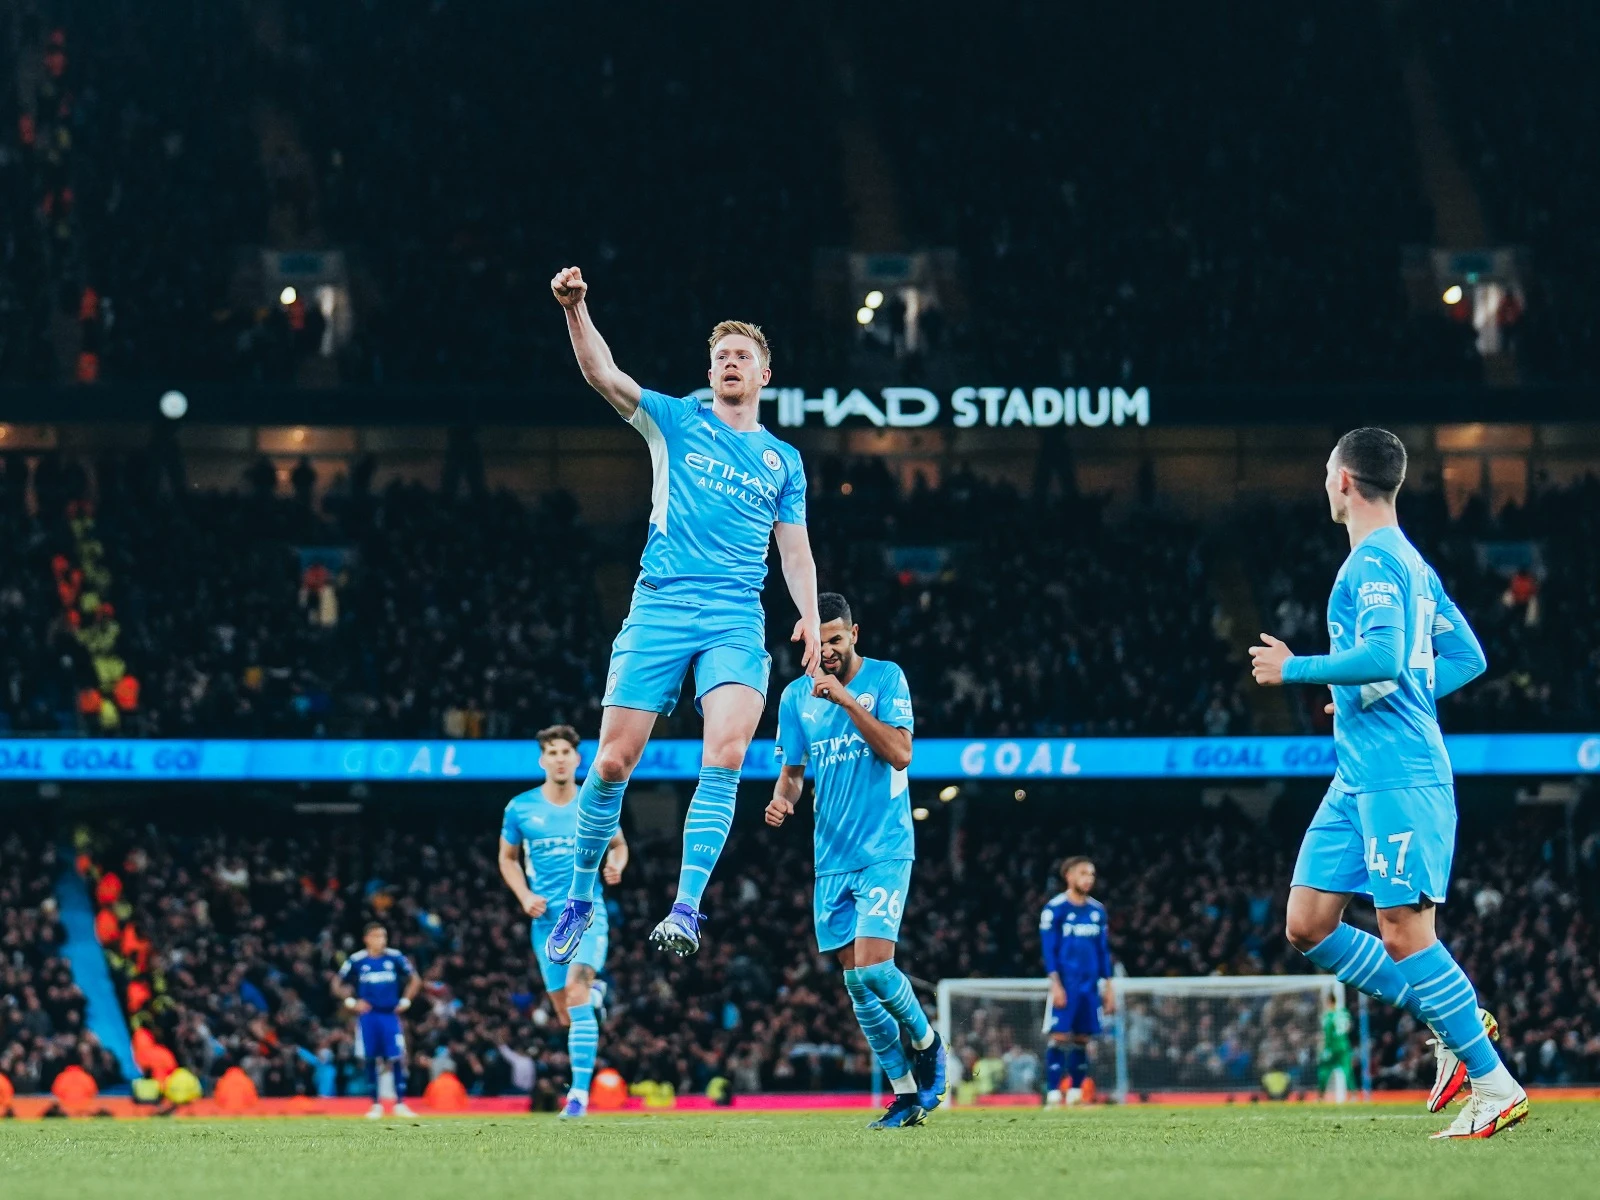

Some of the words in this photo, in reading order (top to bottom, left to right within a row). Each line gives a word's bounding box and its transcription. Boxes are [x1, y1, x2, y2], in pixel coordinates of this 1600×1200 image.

[950, 386, 1150, 427] STADIUM
[697, 477, 764, 507] AIRWAYS
[1362, 594, 1393, 606] TIRE
[1408, 595, 1438, 690] 4
[0, 748, 43, 770] OAL
[61, 747, 135, 771] GOAL
[811, 731, 866, 757] ETIHA
[960, 742, 1081, 775] GOAL
[1193, 745, 1265, 767] GOAL
[1283, 744, 1339, 766] GOA
[343, 744, 462, 776] GOAL
[693, 843, 717, 856] CITY
[1368, 830, 1414, 878] 47
[867, 886, 901, 920] 26
